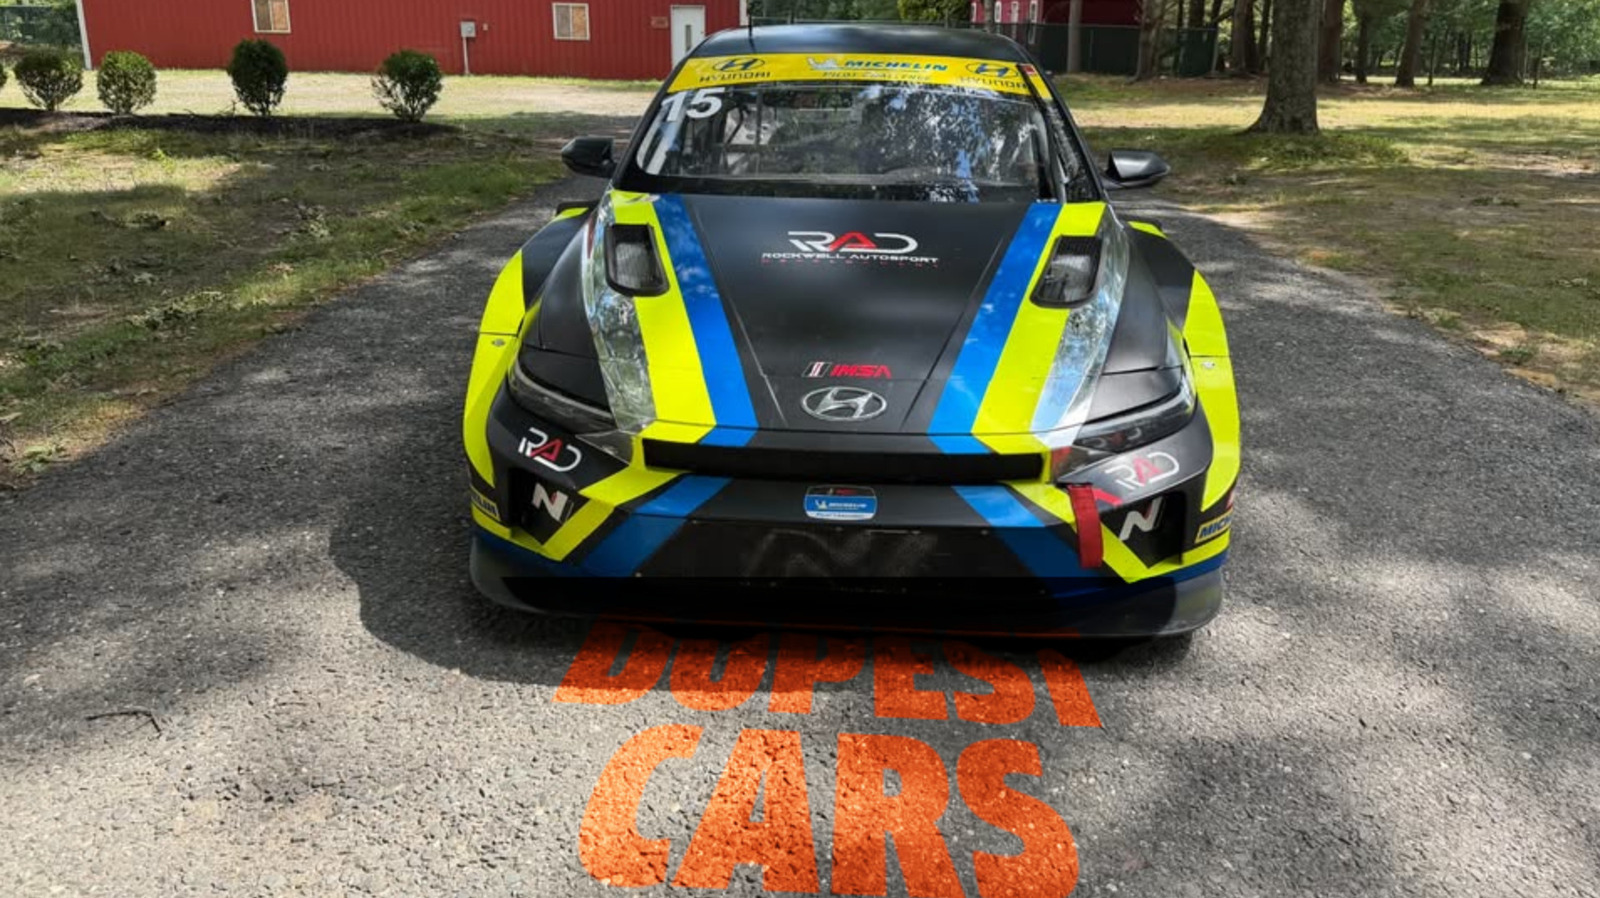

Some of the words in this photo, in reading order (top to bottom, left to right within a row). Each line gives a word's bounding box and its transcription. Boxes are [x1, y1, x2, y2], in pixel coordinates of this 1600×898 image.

[845, 60, 948, 71] MICHELIN
[699, 71, 771, 82] HYUNDAI
[960, 76, 1027, 90] HYUNDA
[661, 87, 726, 121] 15
[787, 230, 918, 254] RAD
[762, 252, 845, 260] ROCKWELL
[849, 253, 939, 263] AUTOSPORT
[829, 364, 893, 379] IMSA
